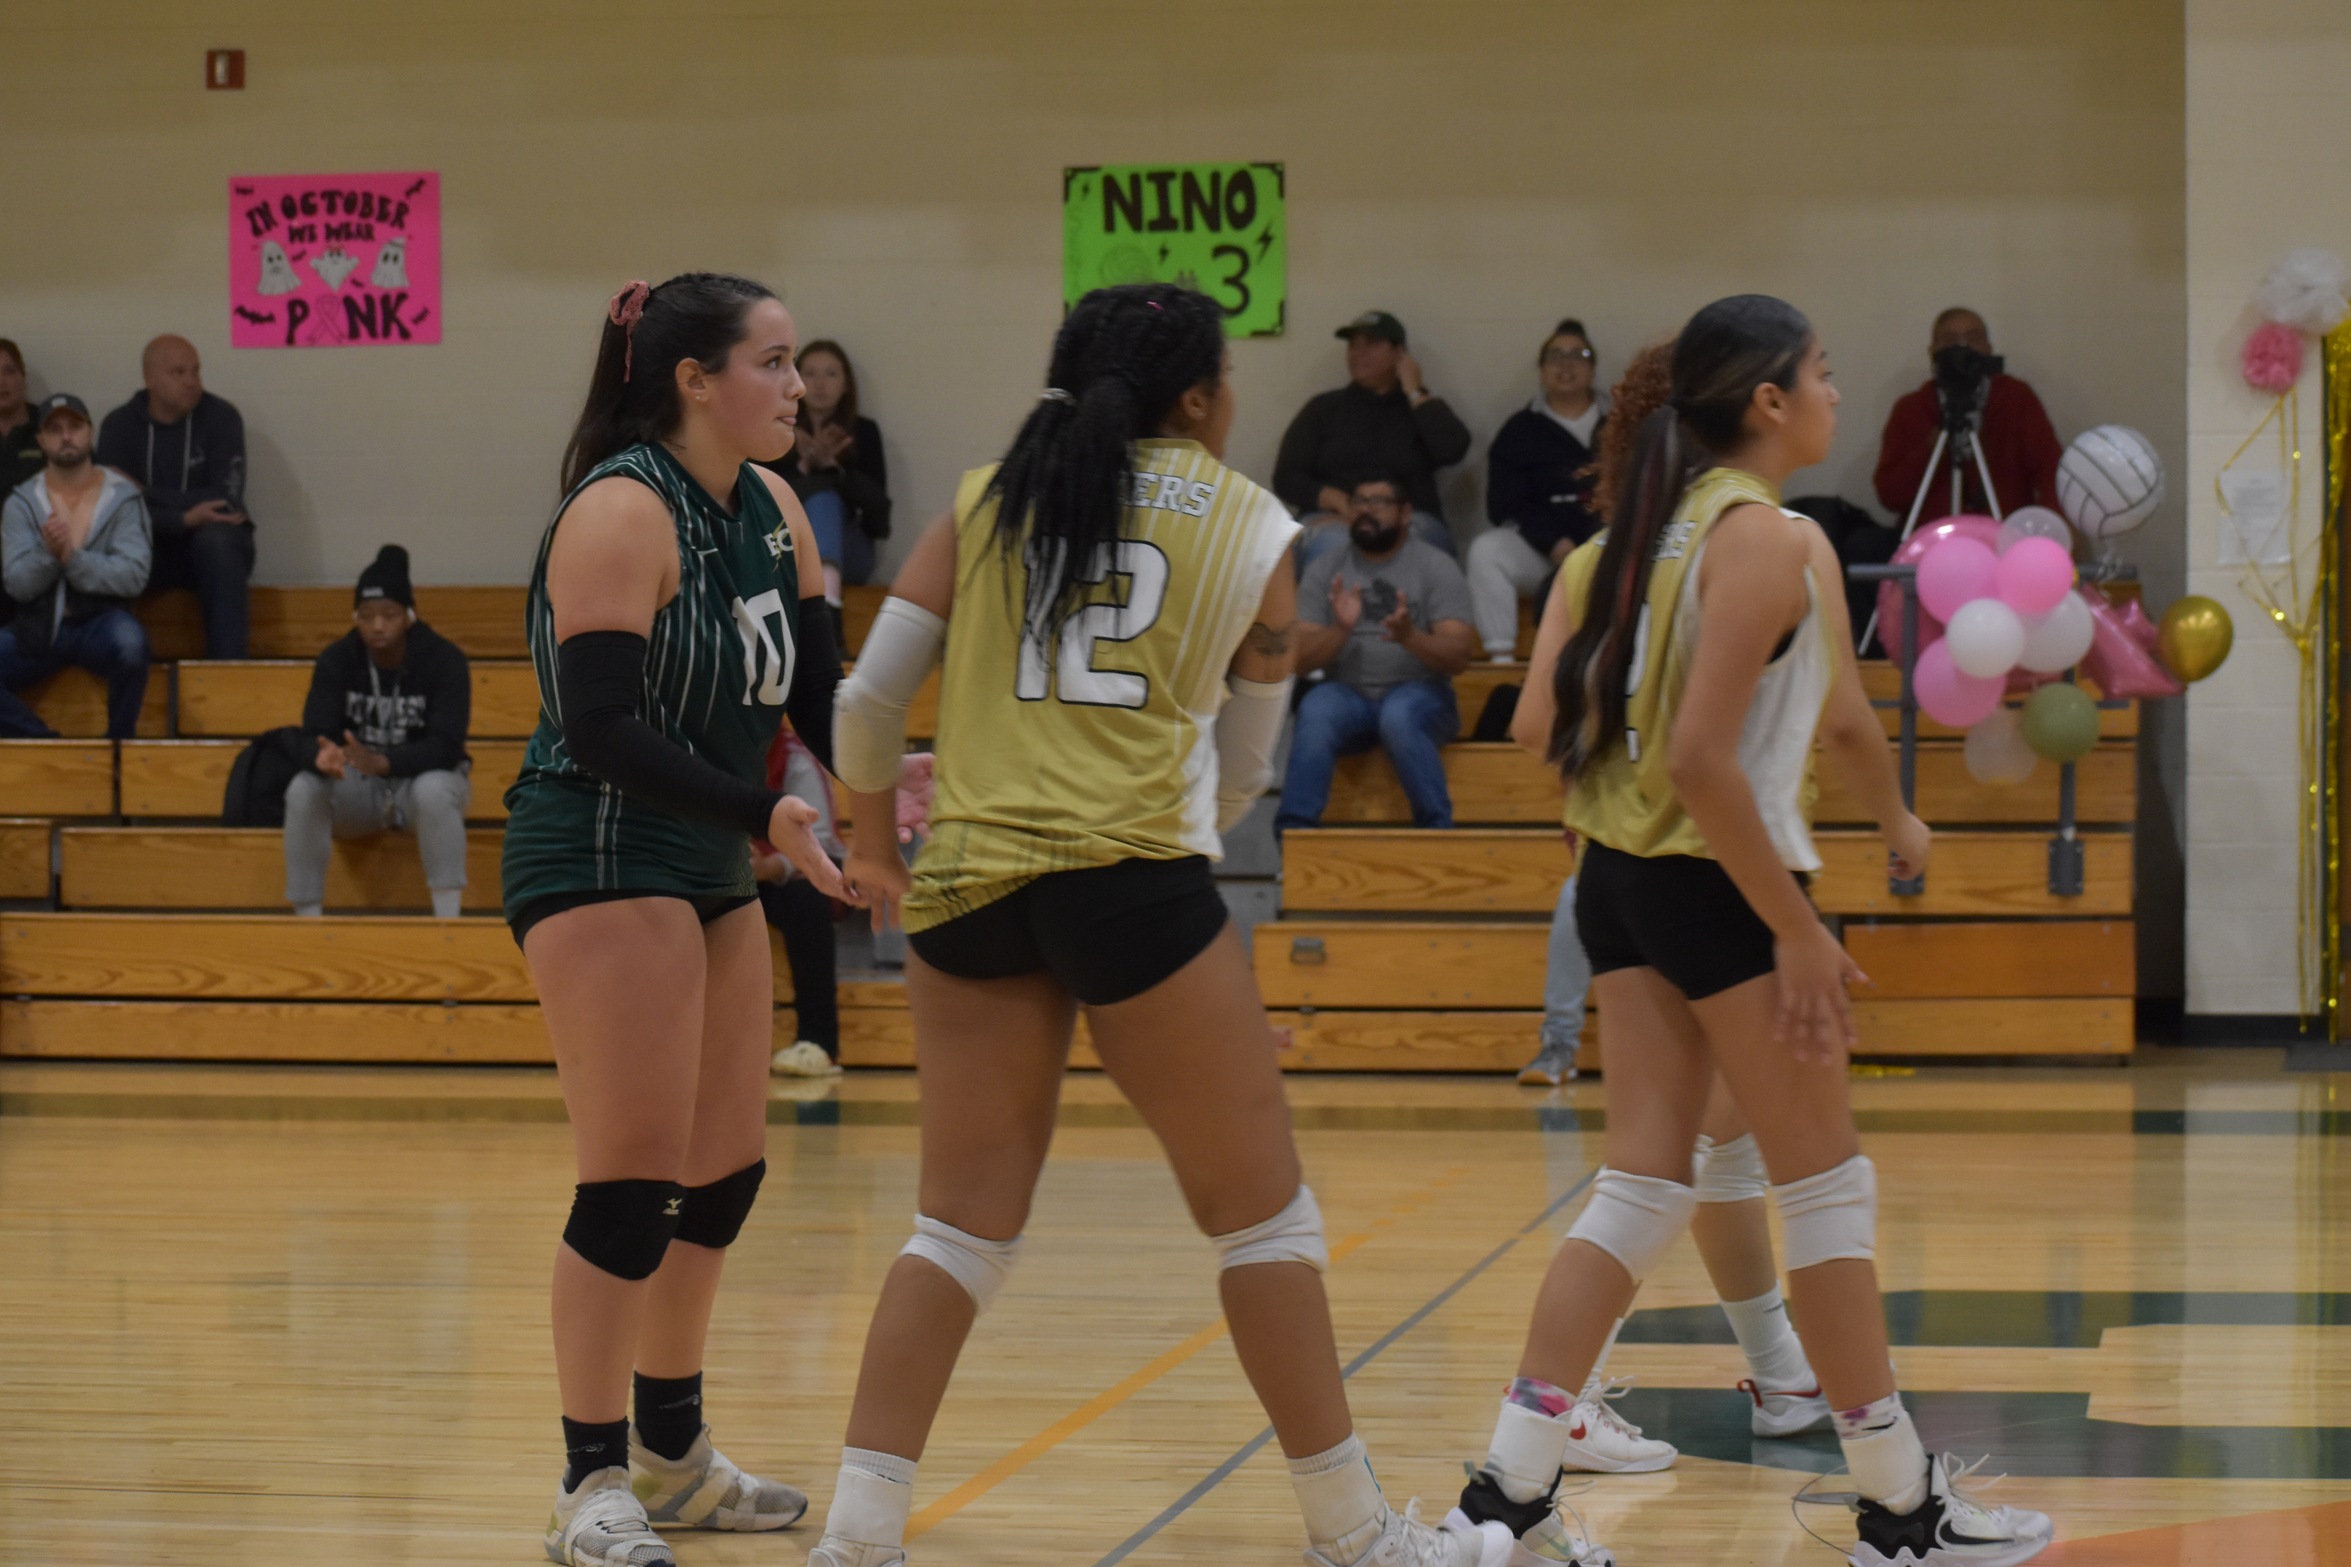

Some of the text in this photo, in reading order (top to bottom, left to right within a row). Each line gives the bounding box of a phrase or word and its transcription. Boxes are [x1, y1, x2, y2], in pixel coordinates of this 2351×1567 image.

[246, 190, 410, 237] IN OCTOBER
[1102, 169, 1257, 233] NINO
[288, 222, 375, 243] WE WEAR
[1124, 471, 1215, 518] ERS
[732, 588, 796, 706] 10
[1015, 537, 1170, 711] 12
